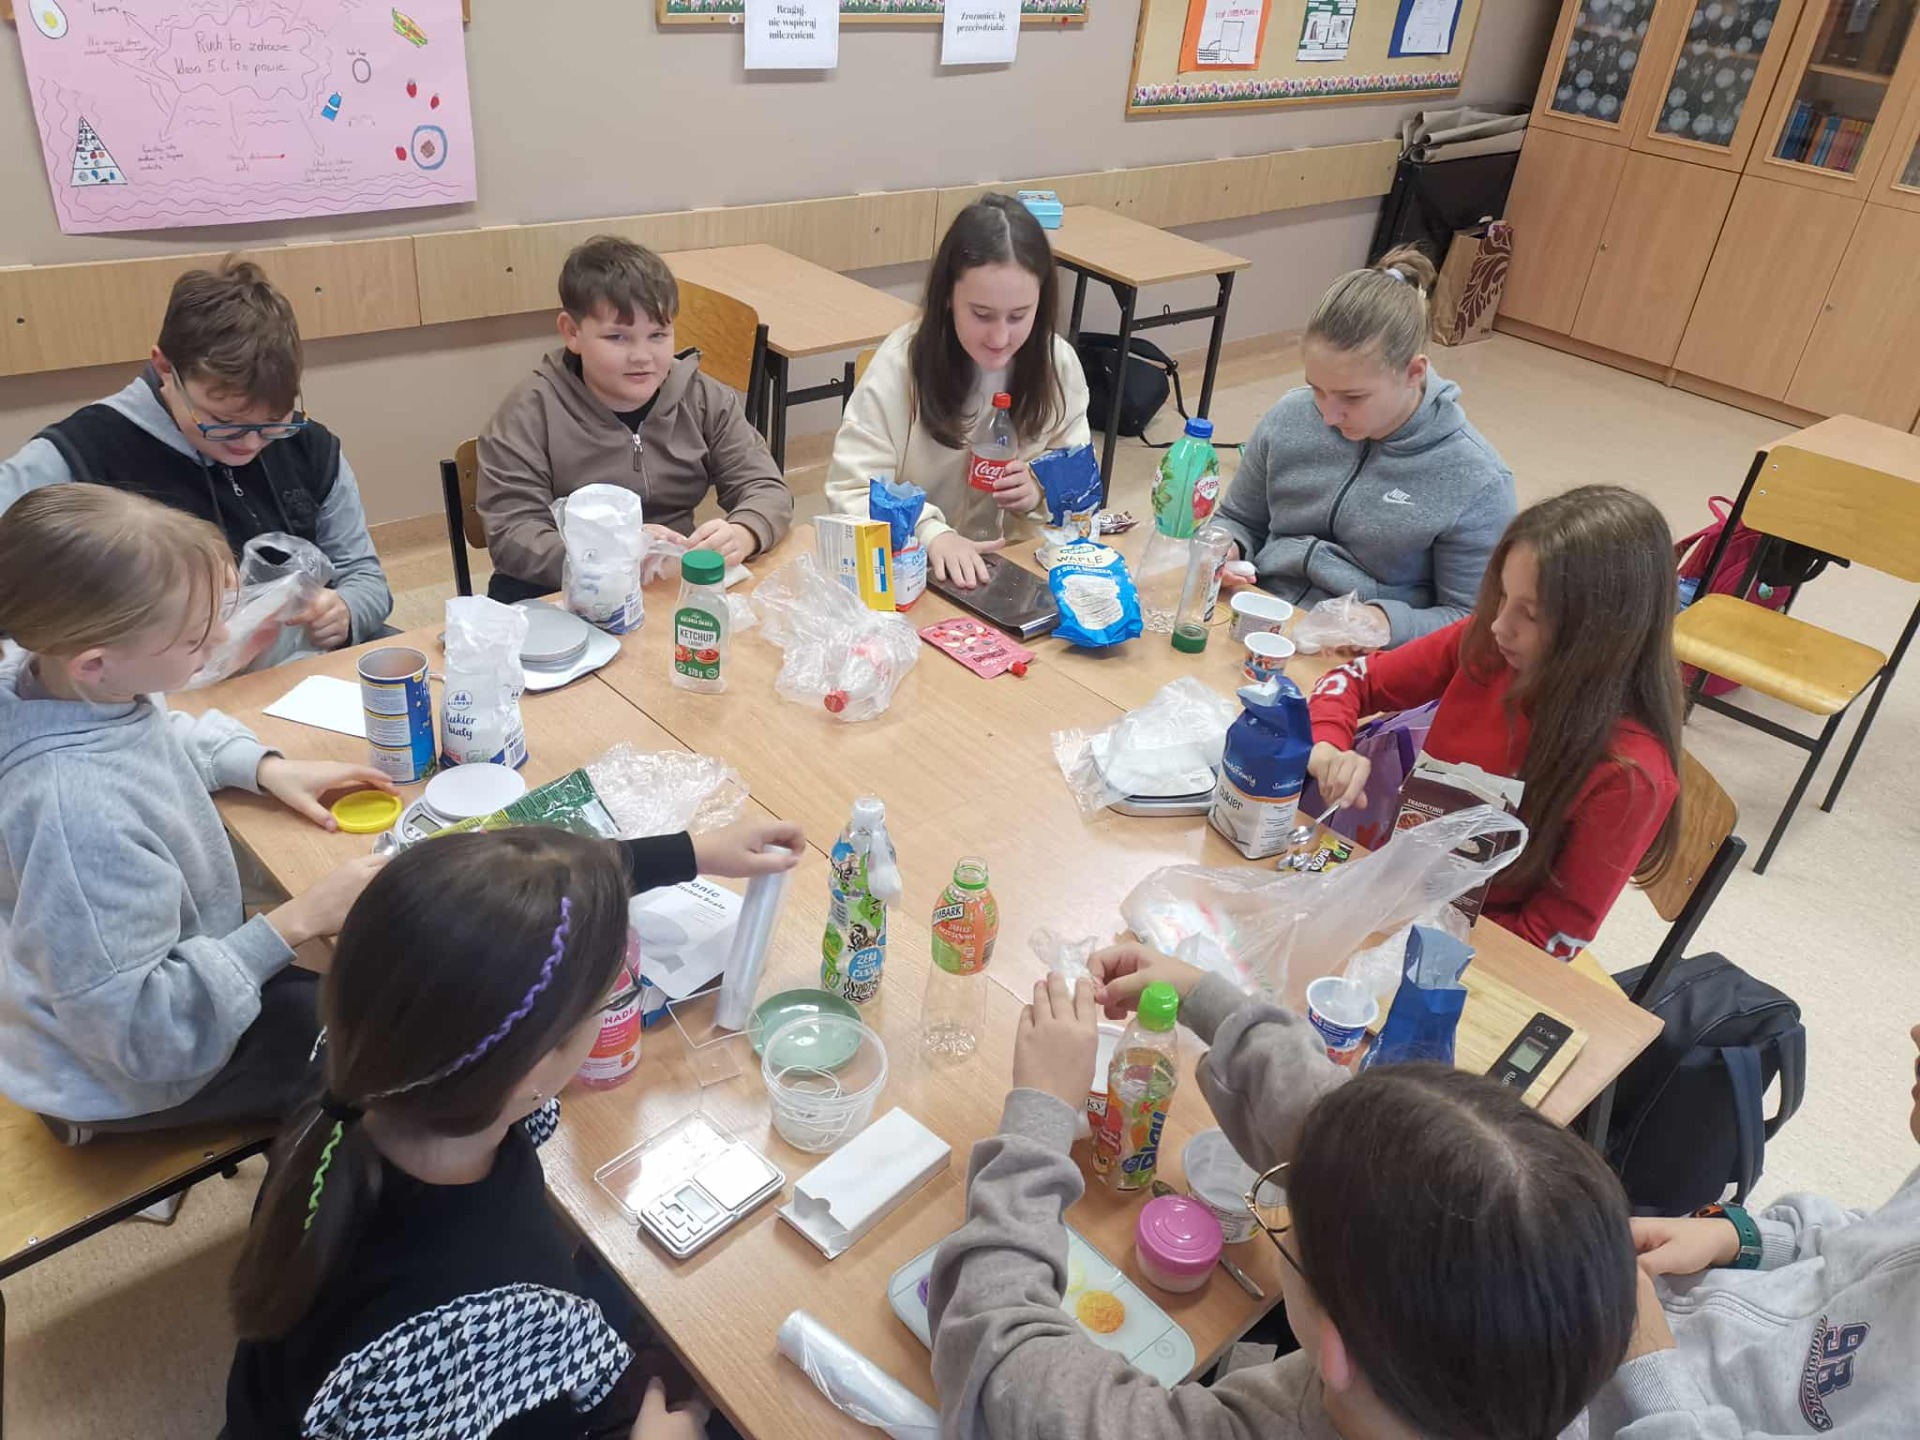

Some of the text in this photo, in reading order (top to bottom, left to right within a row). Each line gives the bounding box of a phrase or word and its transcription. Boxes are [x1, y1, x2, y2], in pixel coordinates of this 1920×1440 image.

[768, 16, 817, 30] nie wspieraj
[228, 32, 242, 52] to
[208, 59, 217, 74] 5
[680, 627, 715, 643] KETCHUP
[445, 712, 477, 725] Cukier
[448, 723, 473, 741] biały
